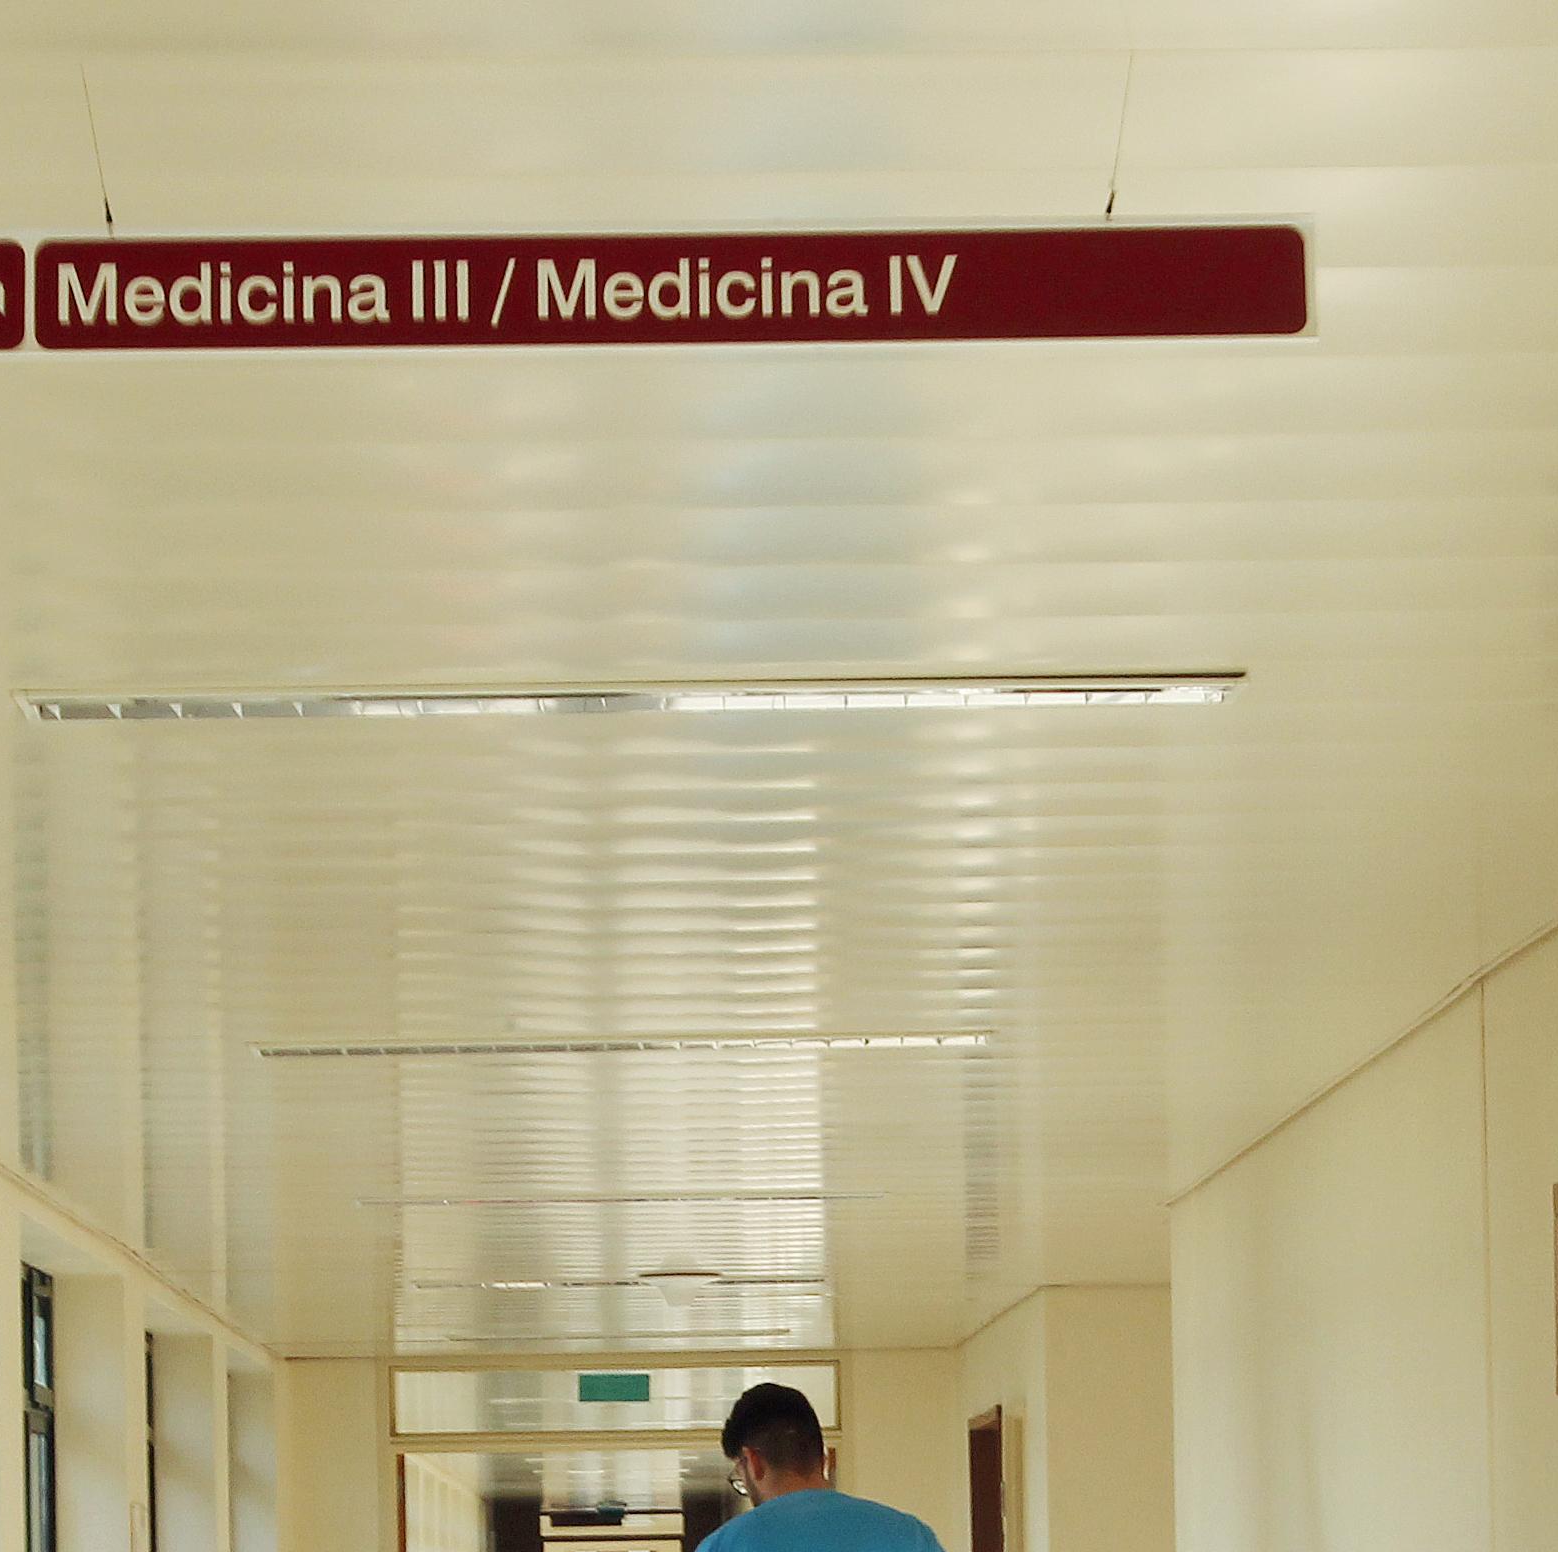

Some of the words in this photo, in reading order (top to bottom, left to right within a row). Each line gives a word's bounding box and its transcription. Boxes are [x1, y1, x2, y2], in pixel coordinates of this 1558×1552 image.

[57, 263, 391, 325] Medicina
[411, 260, 470, 321] III
[491, 258, 515, 326] /
[537, 258, 870, 320] Medicina
[889, 254, 958, 315] IV
